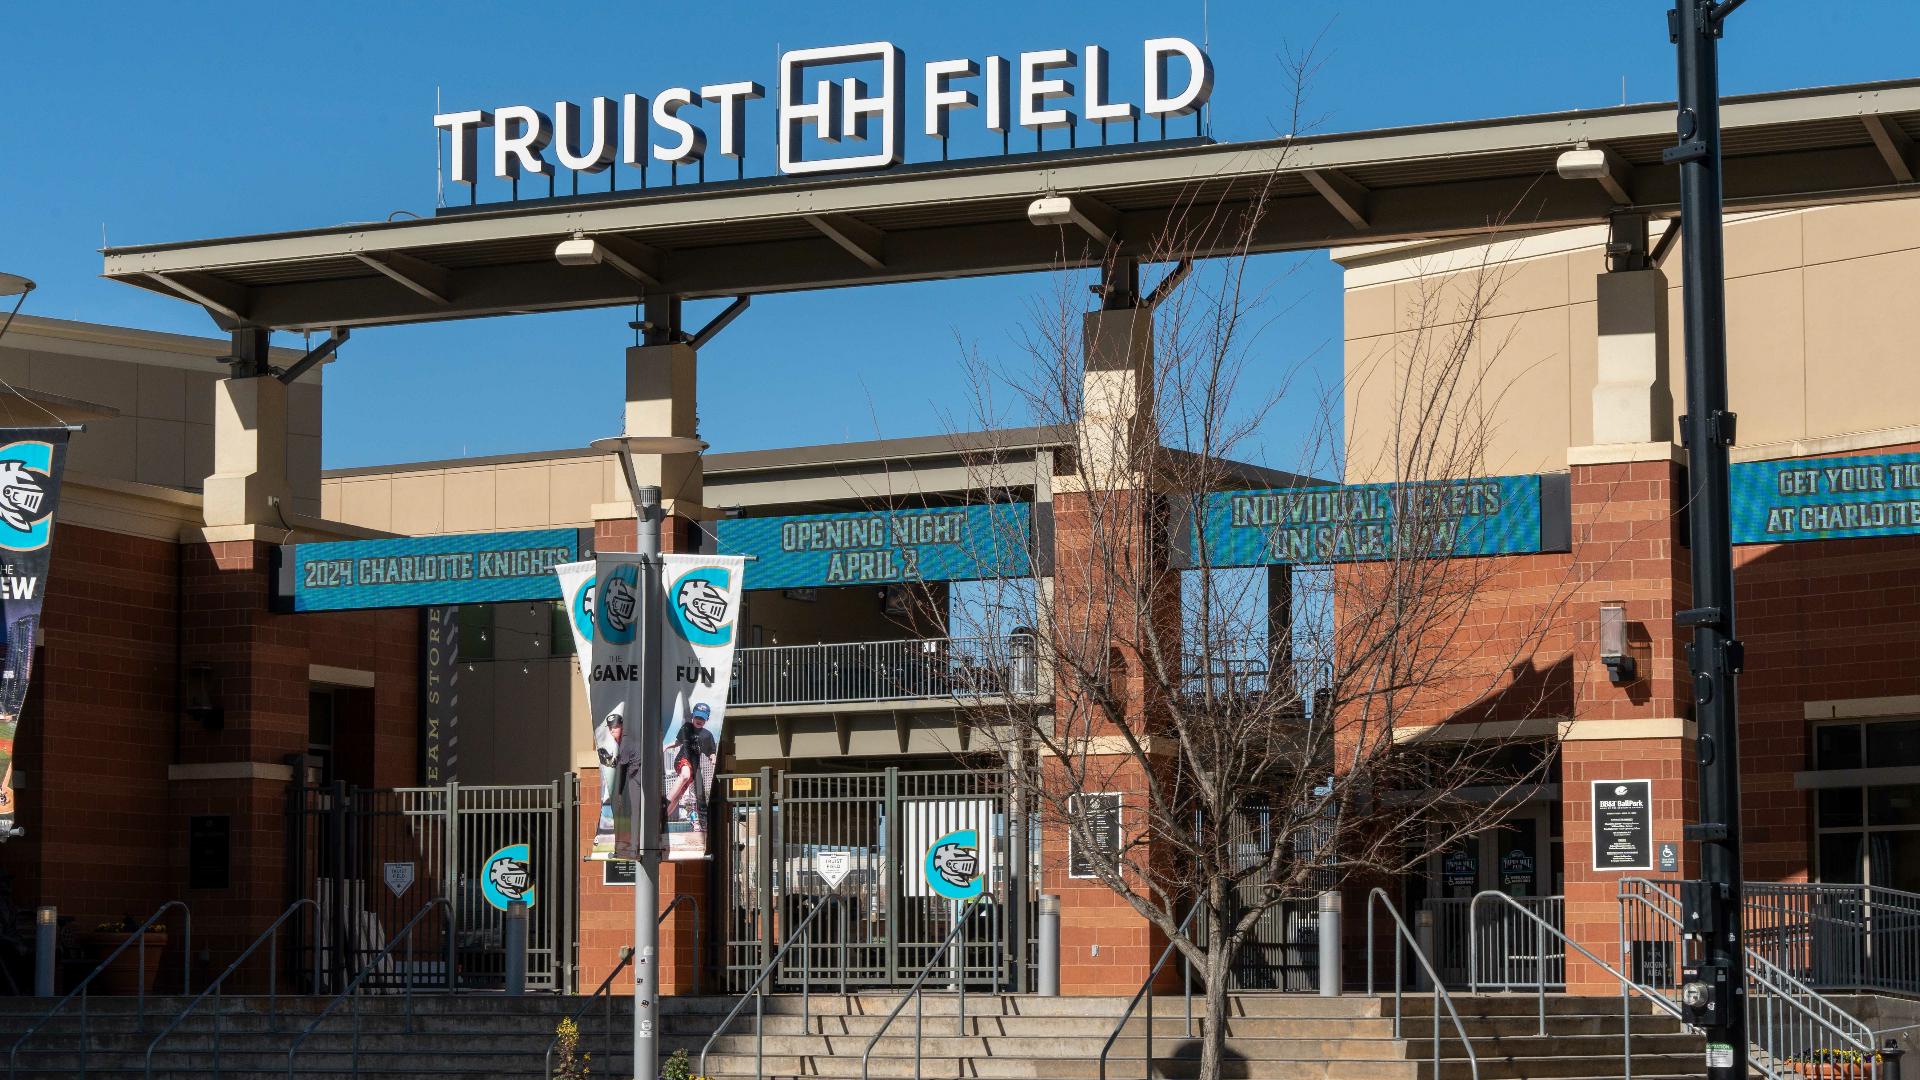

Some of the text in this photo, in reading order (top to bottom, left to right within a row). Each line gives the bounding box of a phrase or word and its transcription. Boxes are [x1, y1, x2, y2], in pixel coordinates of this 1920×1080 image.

[433, 37, 1214, 184] TRUIST FIELD
[1779, 469, 1819, 496] GET
[1824, 464, 1884, 492] YOUR
[1232, 489, 1385, 526] INDIVIDUAL
[1767, 499, 1920, 533] AT CHARLOTTE
[782, 511, 965, 552] OPENING NIGHT
[1273, 519, 1457, 560] ON SALE NW
[304, 546, 570, 588] 2024 CHARLOTTE KNIGHTS
[825, 547, 919, 583] APRIL 2
[429, 608, 440, 705] STORE
[593, 665, 639, 682] GAME
[676, 666, 715, 683] FUN
[688, 657, 703, 665] THE
